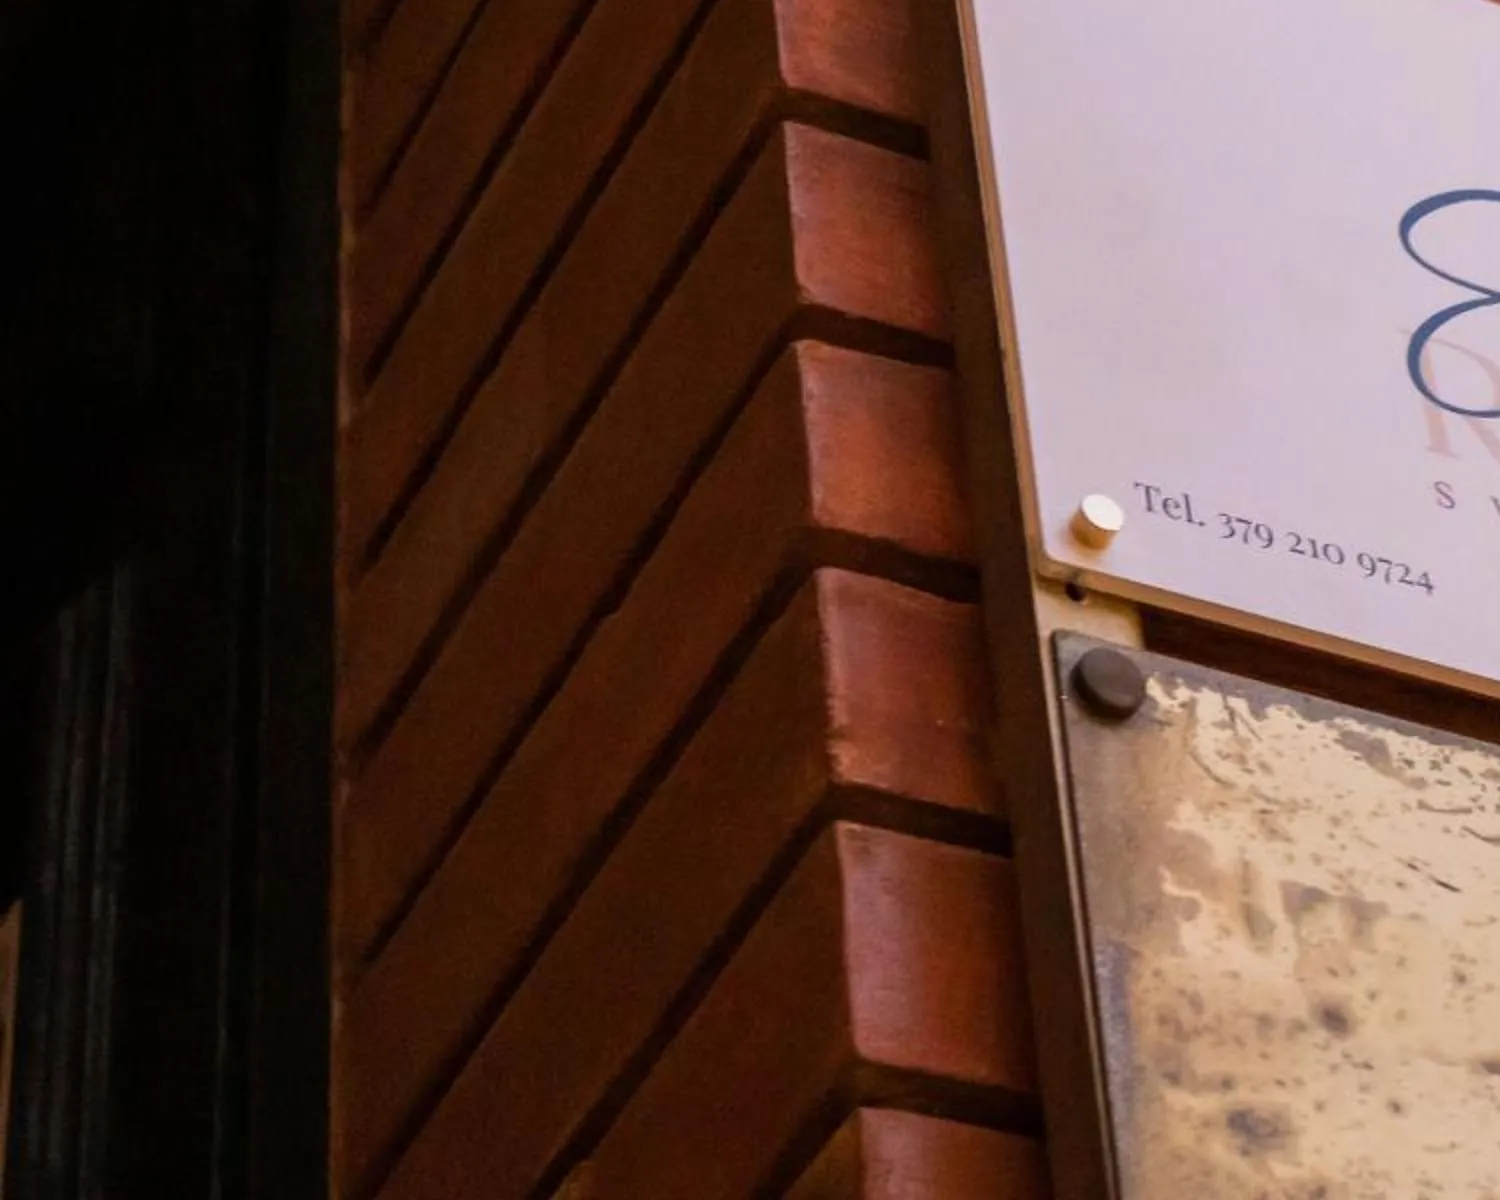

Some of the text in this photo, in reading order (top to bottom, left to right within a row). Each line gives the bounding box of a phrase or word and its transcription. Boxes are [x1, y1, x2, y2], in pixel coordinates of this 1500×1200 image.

[1133, 481, 1435, 596] Tel. 379 210 9724
